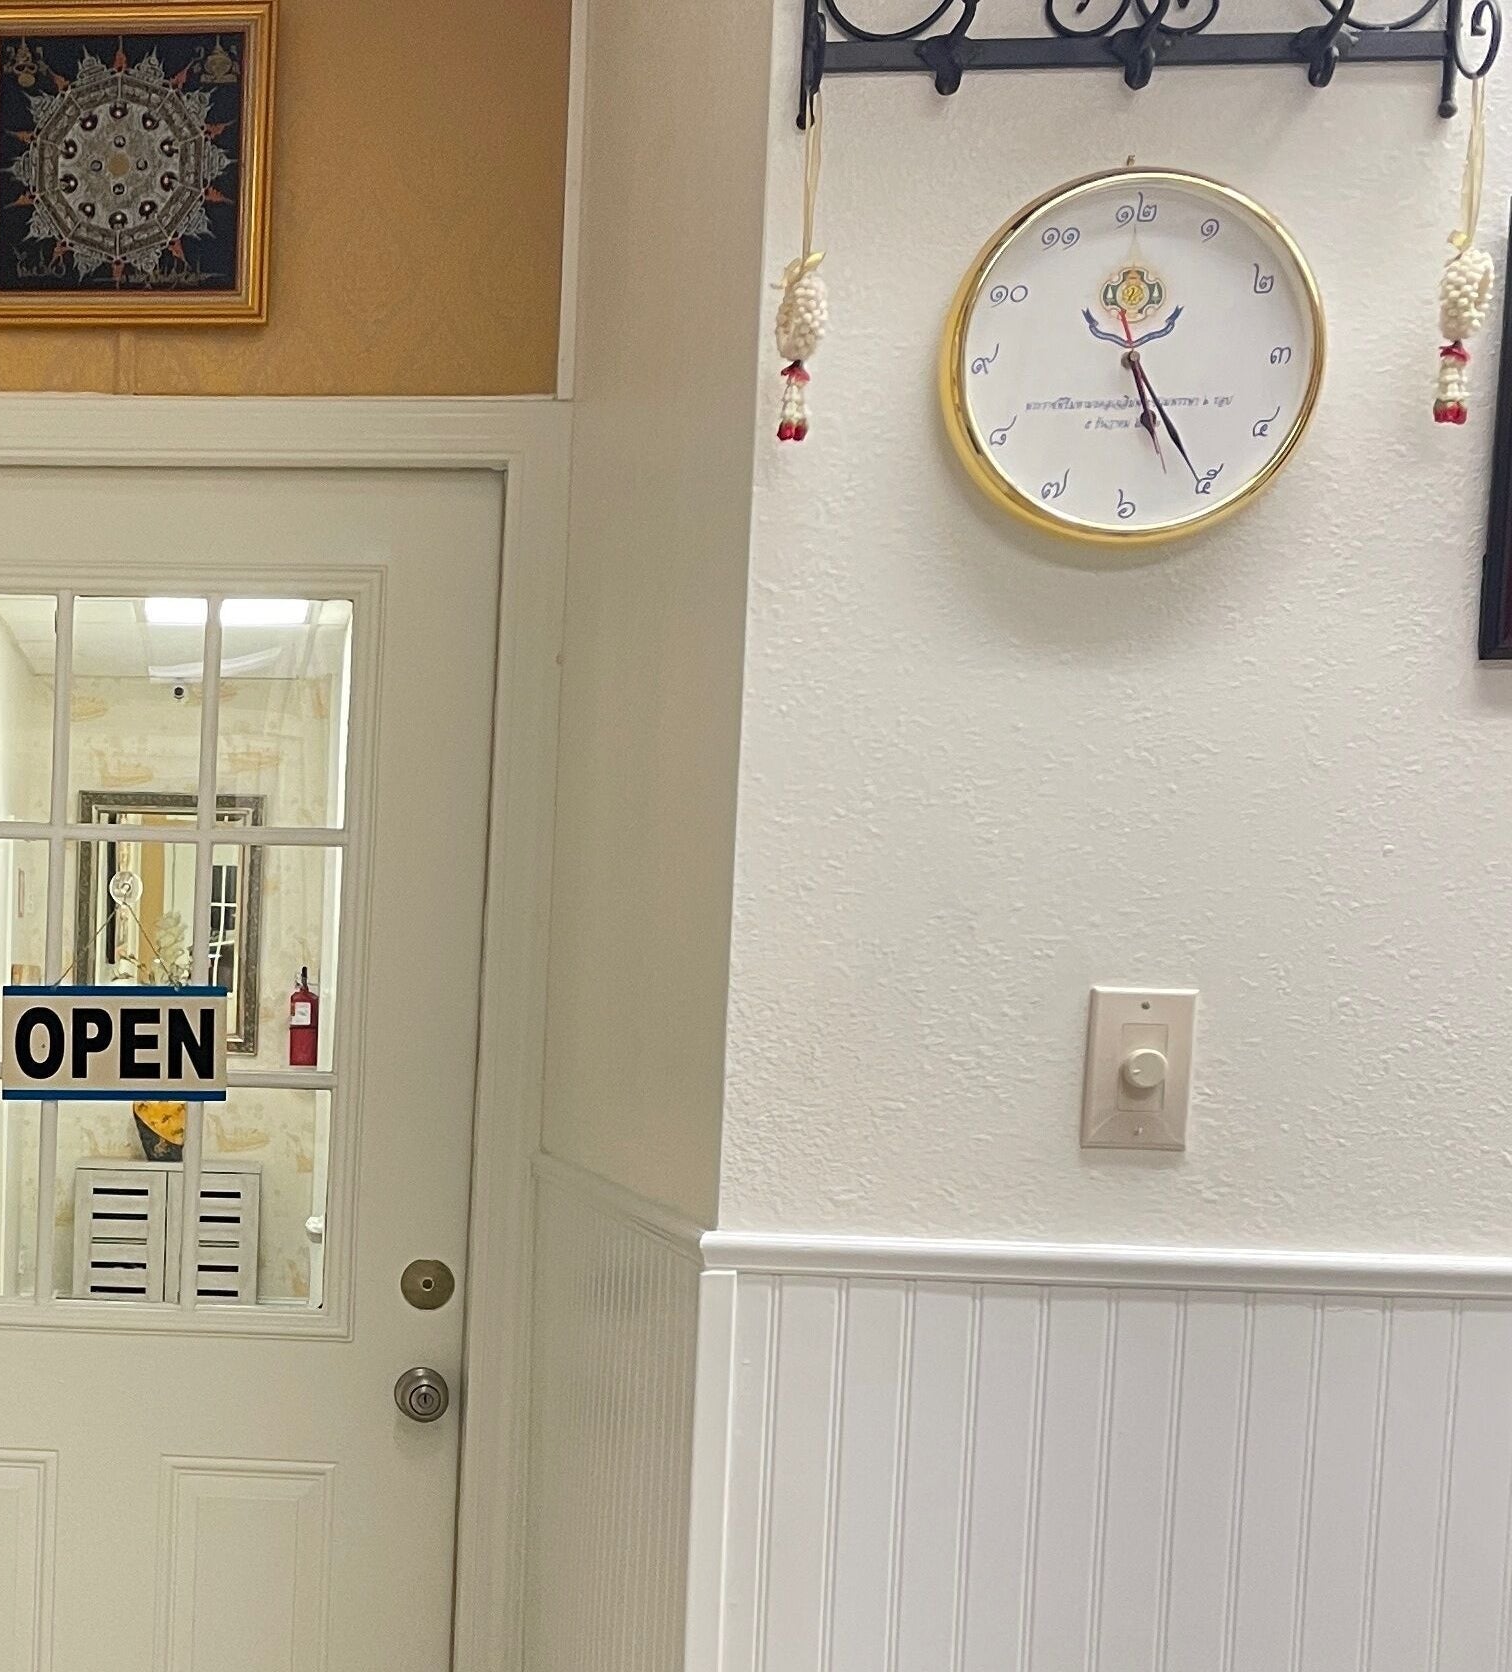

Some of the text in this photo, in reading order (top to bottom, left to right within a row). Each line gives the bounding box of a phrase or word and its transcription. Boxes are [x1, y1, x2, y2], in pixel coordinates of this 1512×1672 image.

[1116, 192, 1158, 229] ๑๒
[1041, 227, 1080, 251] ๑๑
[1200, 218, 1220, 244] ๑
[1253, 263, 1274, 294] ๒
[990, 284, 1028, 307] ๑๐
[1270, 346, 1292, 365] ๓
[990, 416, 1017, 446] ๘
[1253, 407, 1280, 437] ๔
[1041, 469, 1070, 499] ๗
[1118, 490, 1136, 519] ๖
[15, 1006, 215, 1080] OPEN
